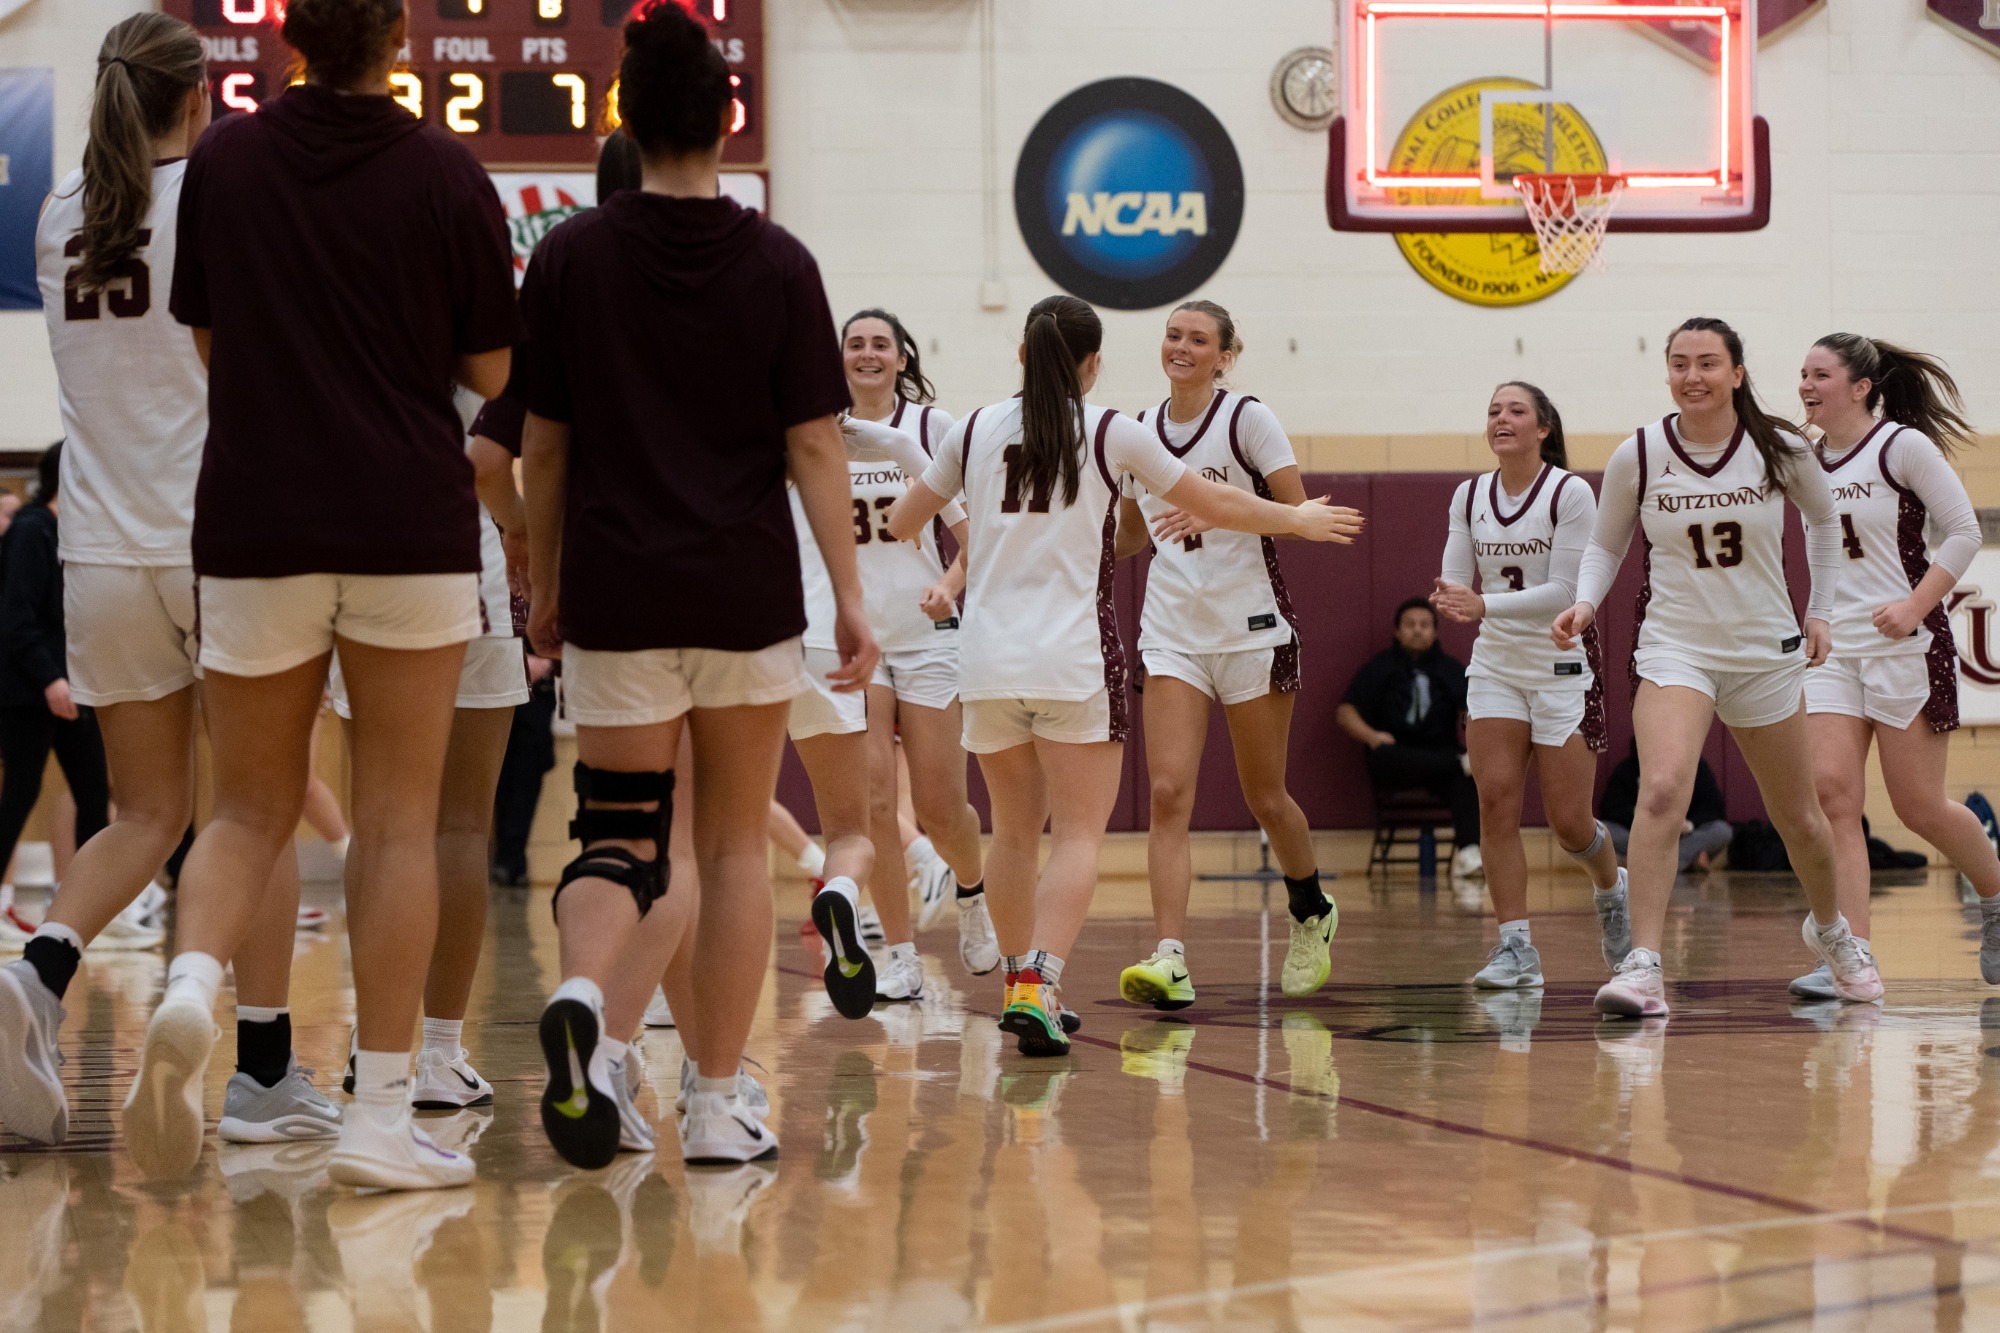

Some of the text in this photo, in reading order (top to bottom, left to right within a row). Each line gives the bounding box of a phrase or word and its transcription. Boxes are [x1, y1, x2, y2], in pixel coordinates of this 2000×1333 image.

[203, 36, 259, 62] OULS
[433, 37, 496, 62] FOUL
[521, 37, 568, 63] PTS
[446, 73, 483, 133] 2
[552, 73, 586, 129] 7
[1061, 192, 1208, 236] NCAA
[1413, 238, 1520, 295] FOUNDED 1906
[1656, 486, 1765, 512] KUTZTOWN
[1688, 521, 1742, 569] 13
